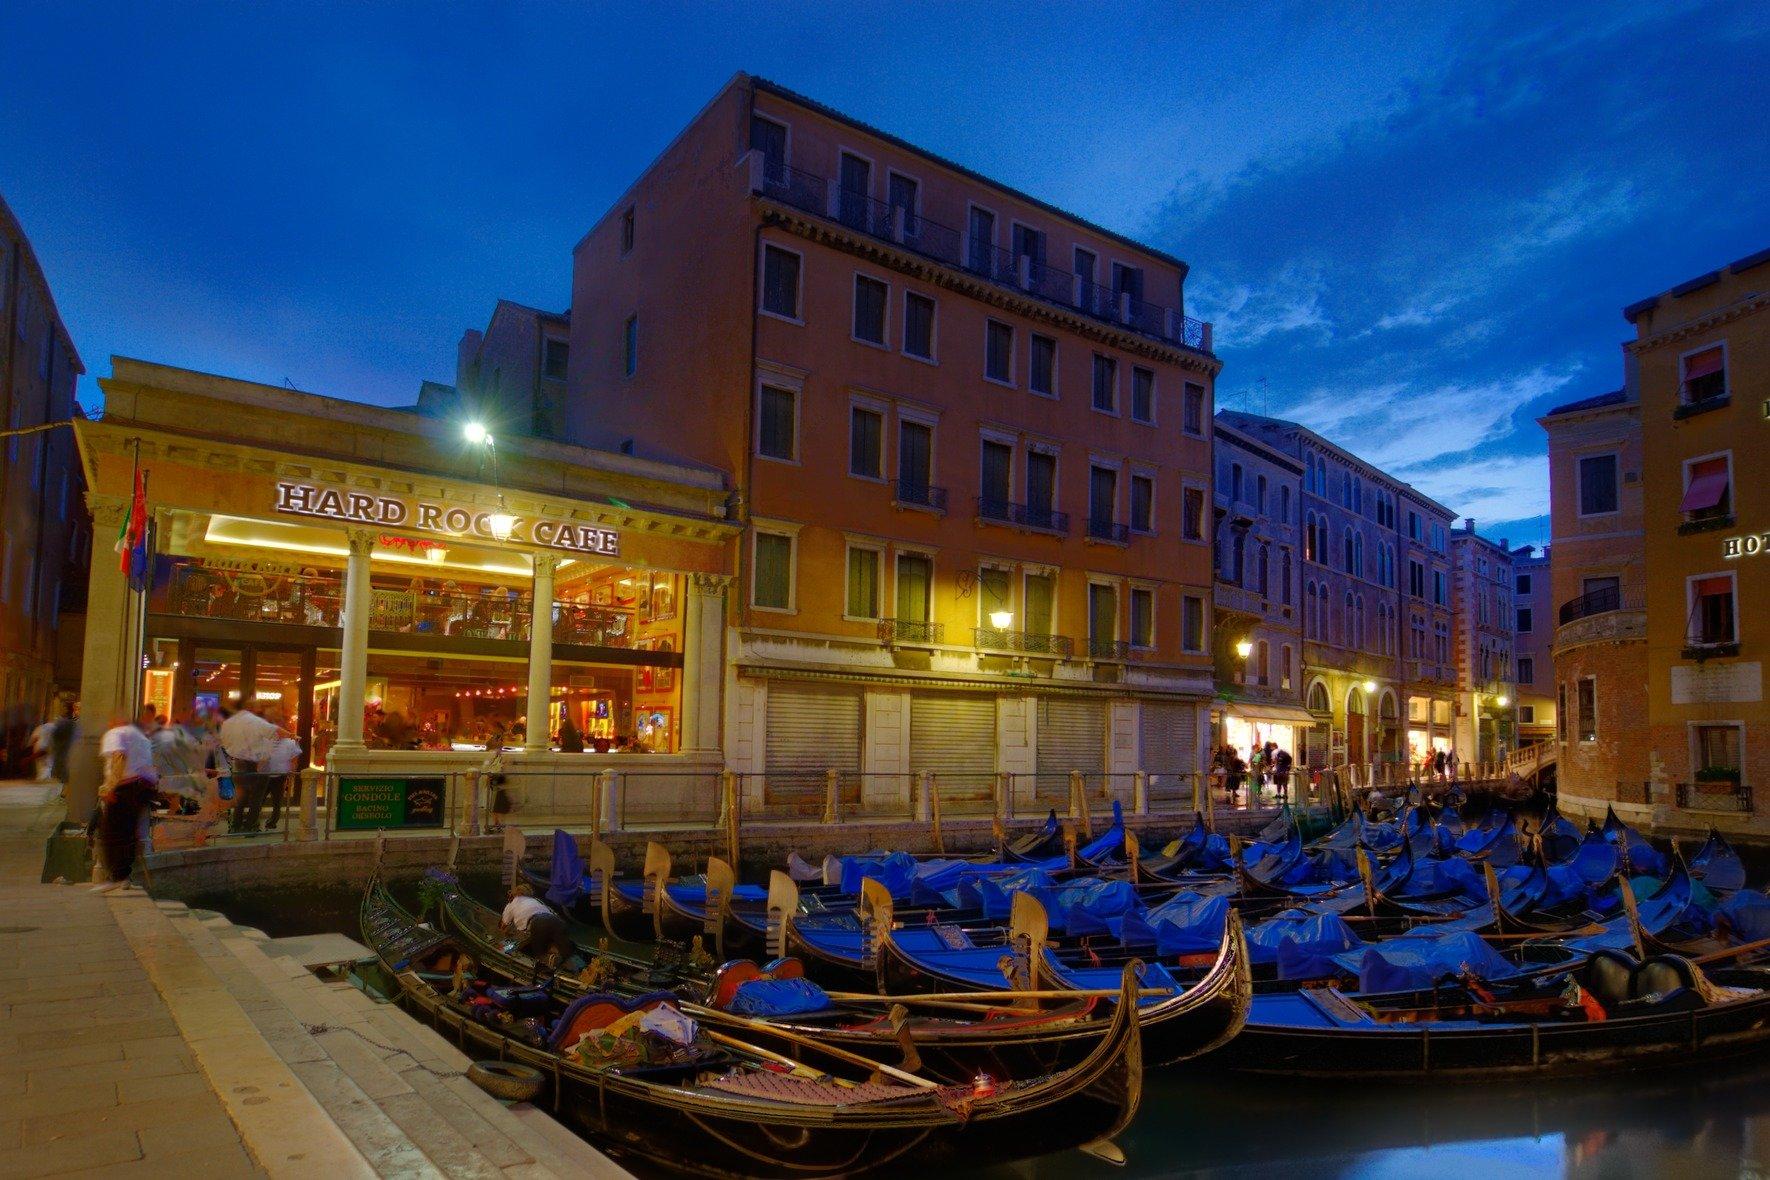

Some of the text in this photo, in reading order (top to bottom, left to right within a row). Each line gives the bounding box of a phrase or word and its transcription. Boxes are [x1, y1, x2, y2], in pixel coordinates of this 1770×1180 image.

[278, 483, 408, 525] HARD
[533, 521, 620, 554] CAFE
[352, 784, 394, 792] SERVIZIO
[344, 792, 401, 802] GONDOLE
[356, 804, 389, 812] BACINO
